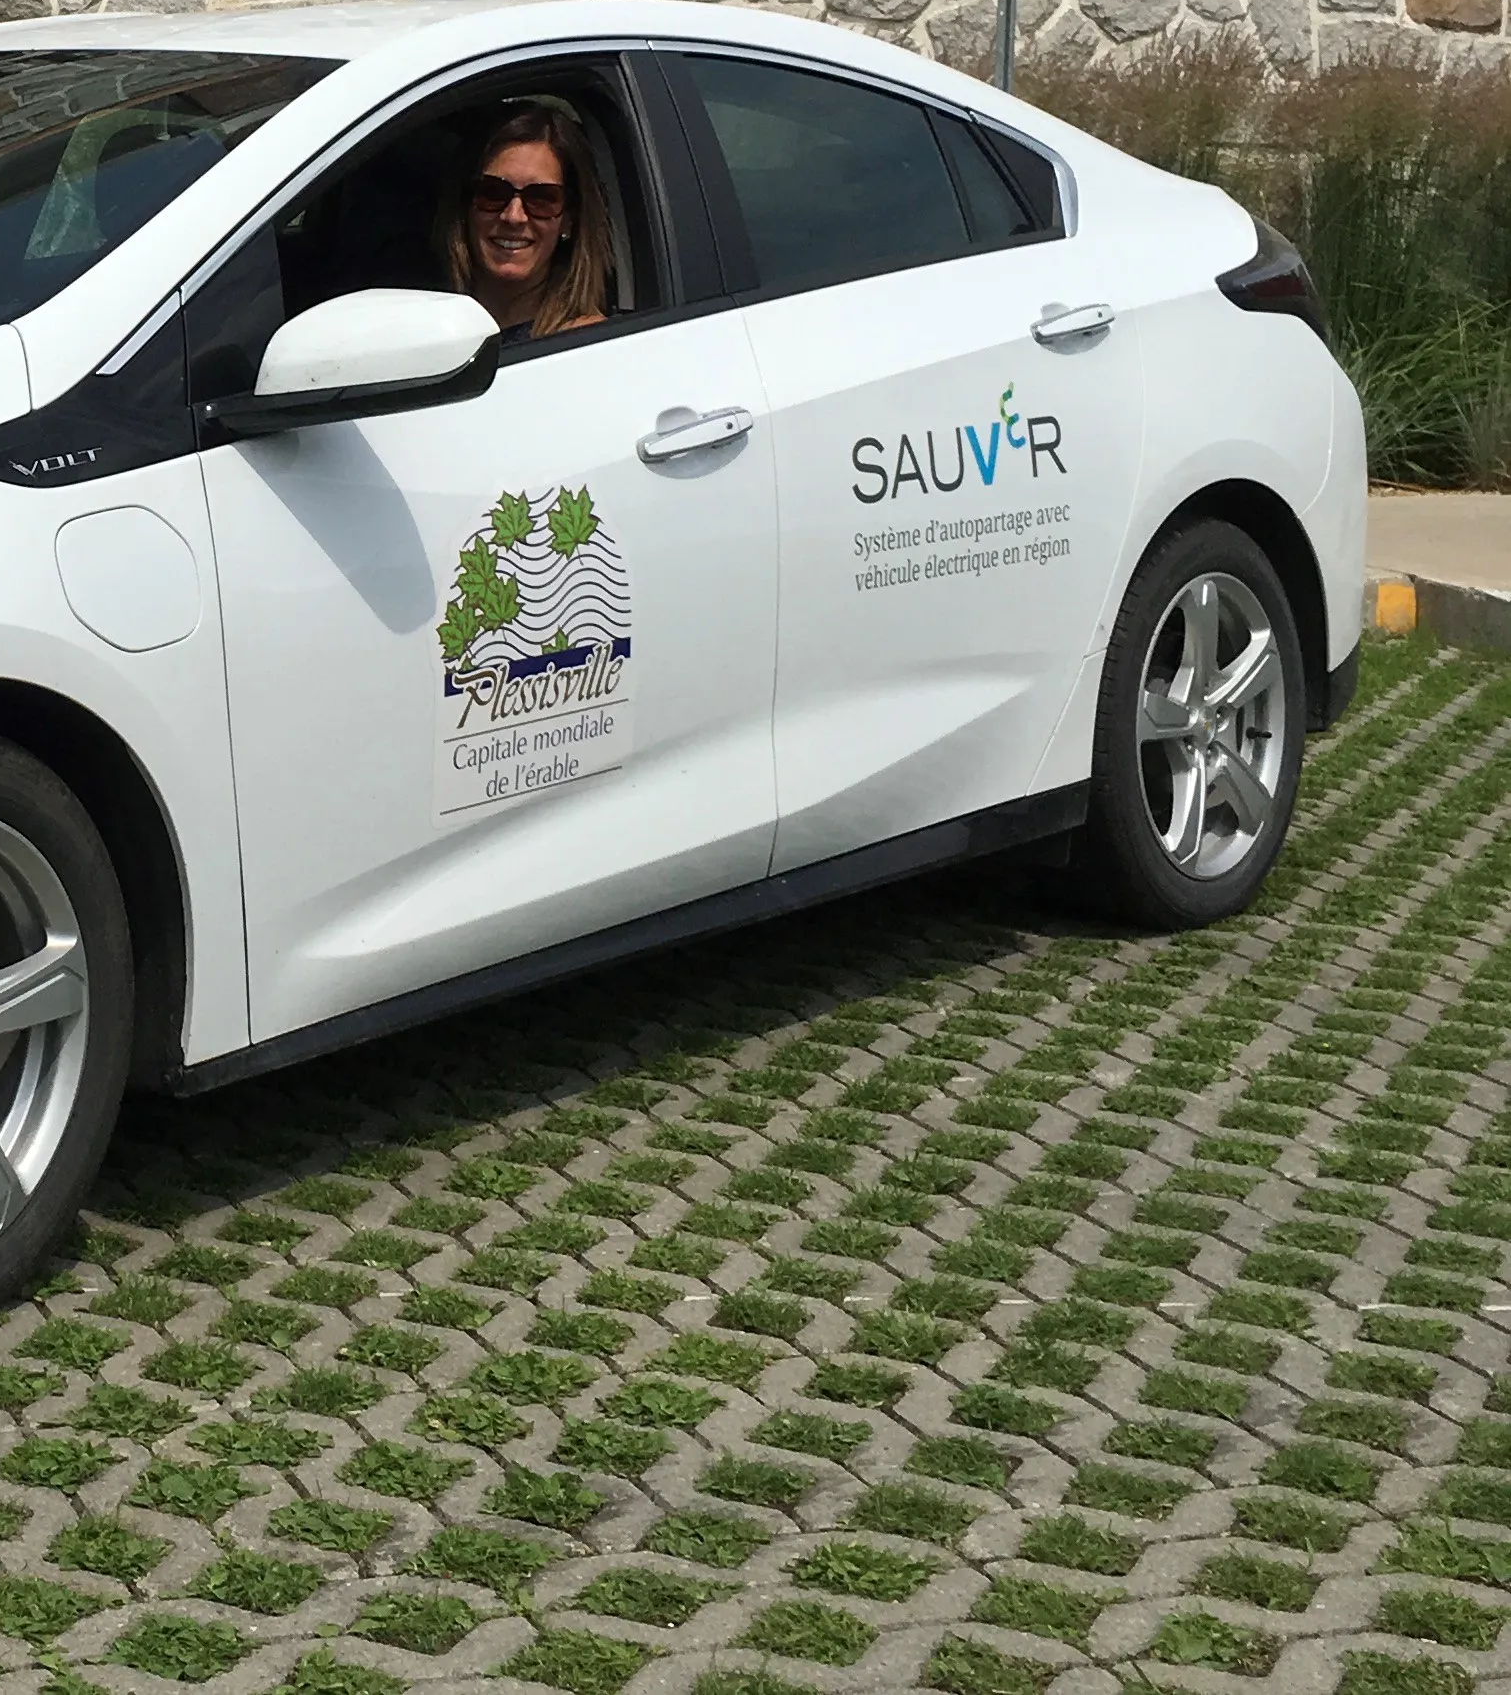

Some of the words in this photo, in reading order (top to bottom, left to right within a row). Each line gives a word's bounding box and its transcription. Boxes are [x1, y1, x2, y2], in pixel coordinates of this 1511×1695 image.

[8, 447, 102, 478] VOLT
[854, 526, 921, 562] Système
[925, 509, 1033, 543] d'autopartage
[1036, 504, 1071, 526] avec
[855, 558, 920, 592] véhicule
[924, 547, 999, 578] électrique
[1002, 544, 1021, 566] en
[1024, 534, 1071, 566] région
[452, 642, 625, 730] Plessisville
[453, 730, 528, 772] Capitale
[533, 709, 614, 752] mondiale
[486, 771, 509, 798] de
[515, 752, 580, 791] l'érable
